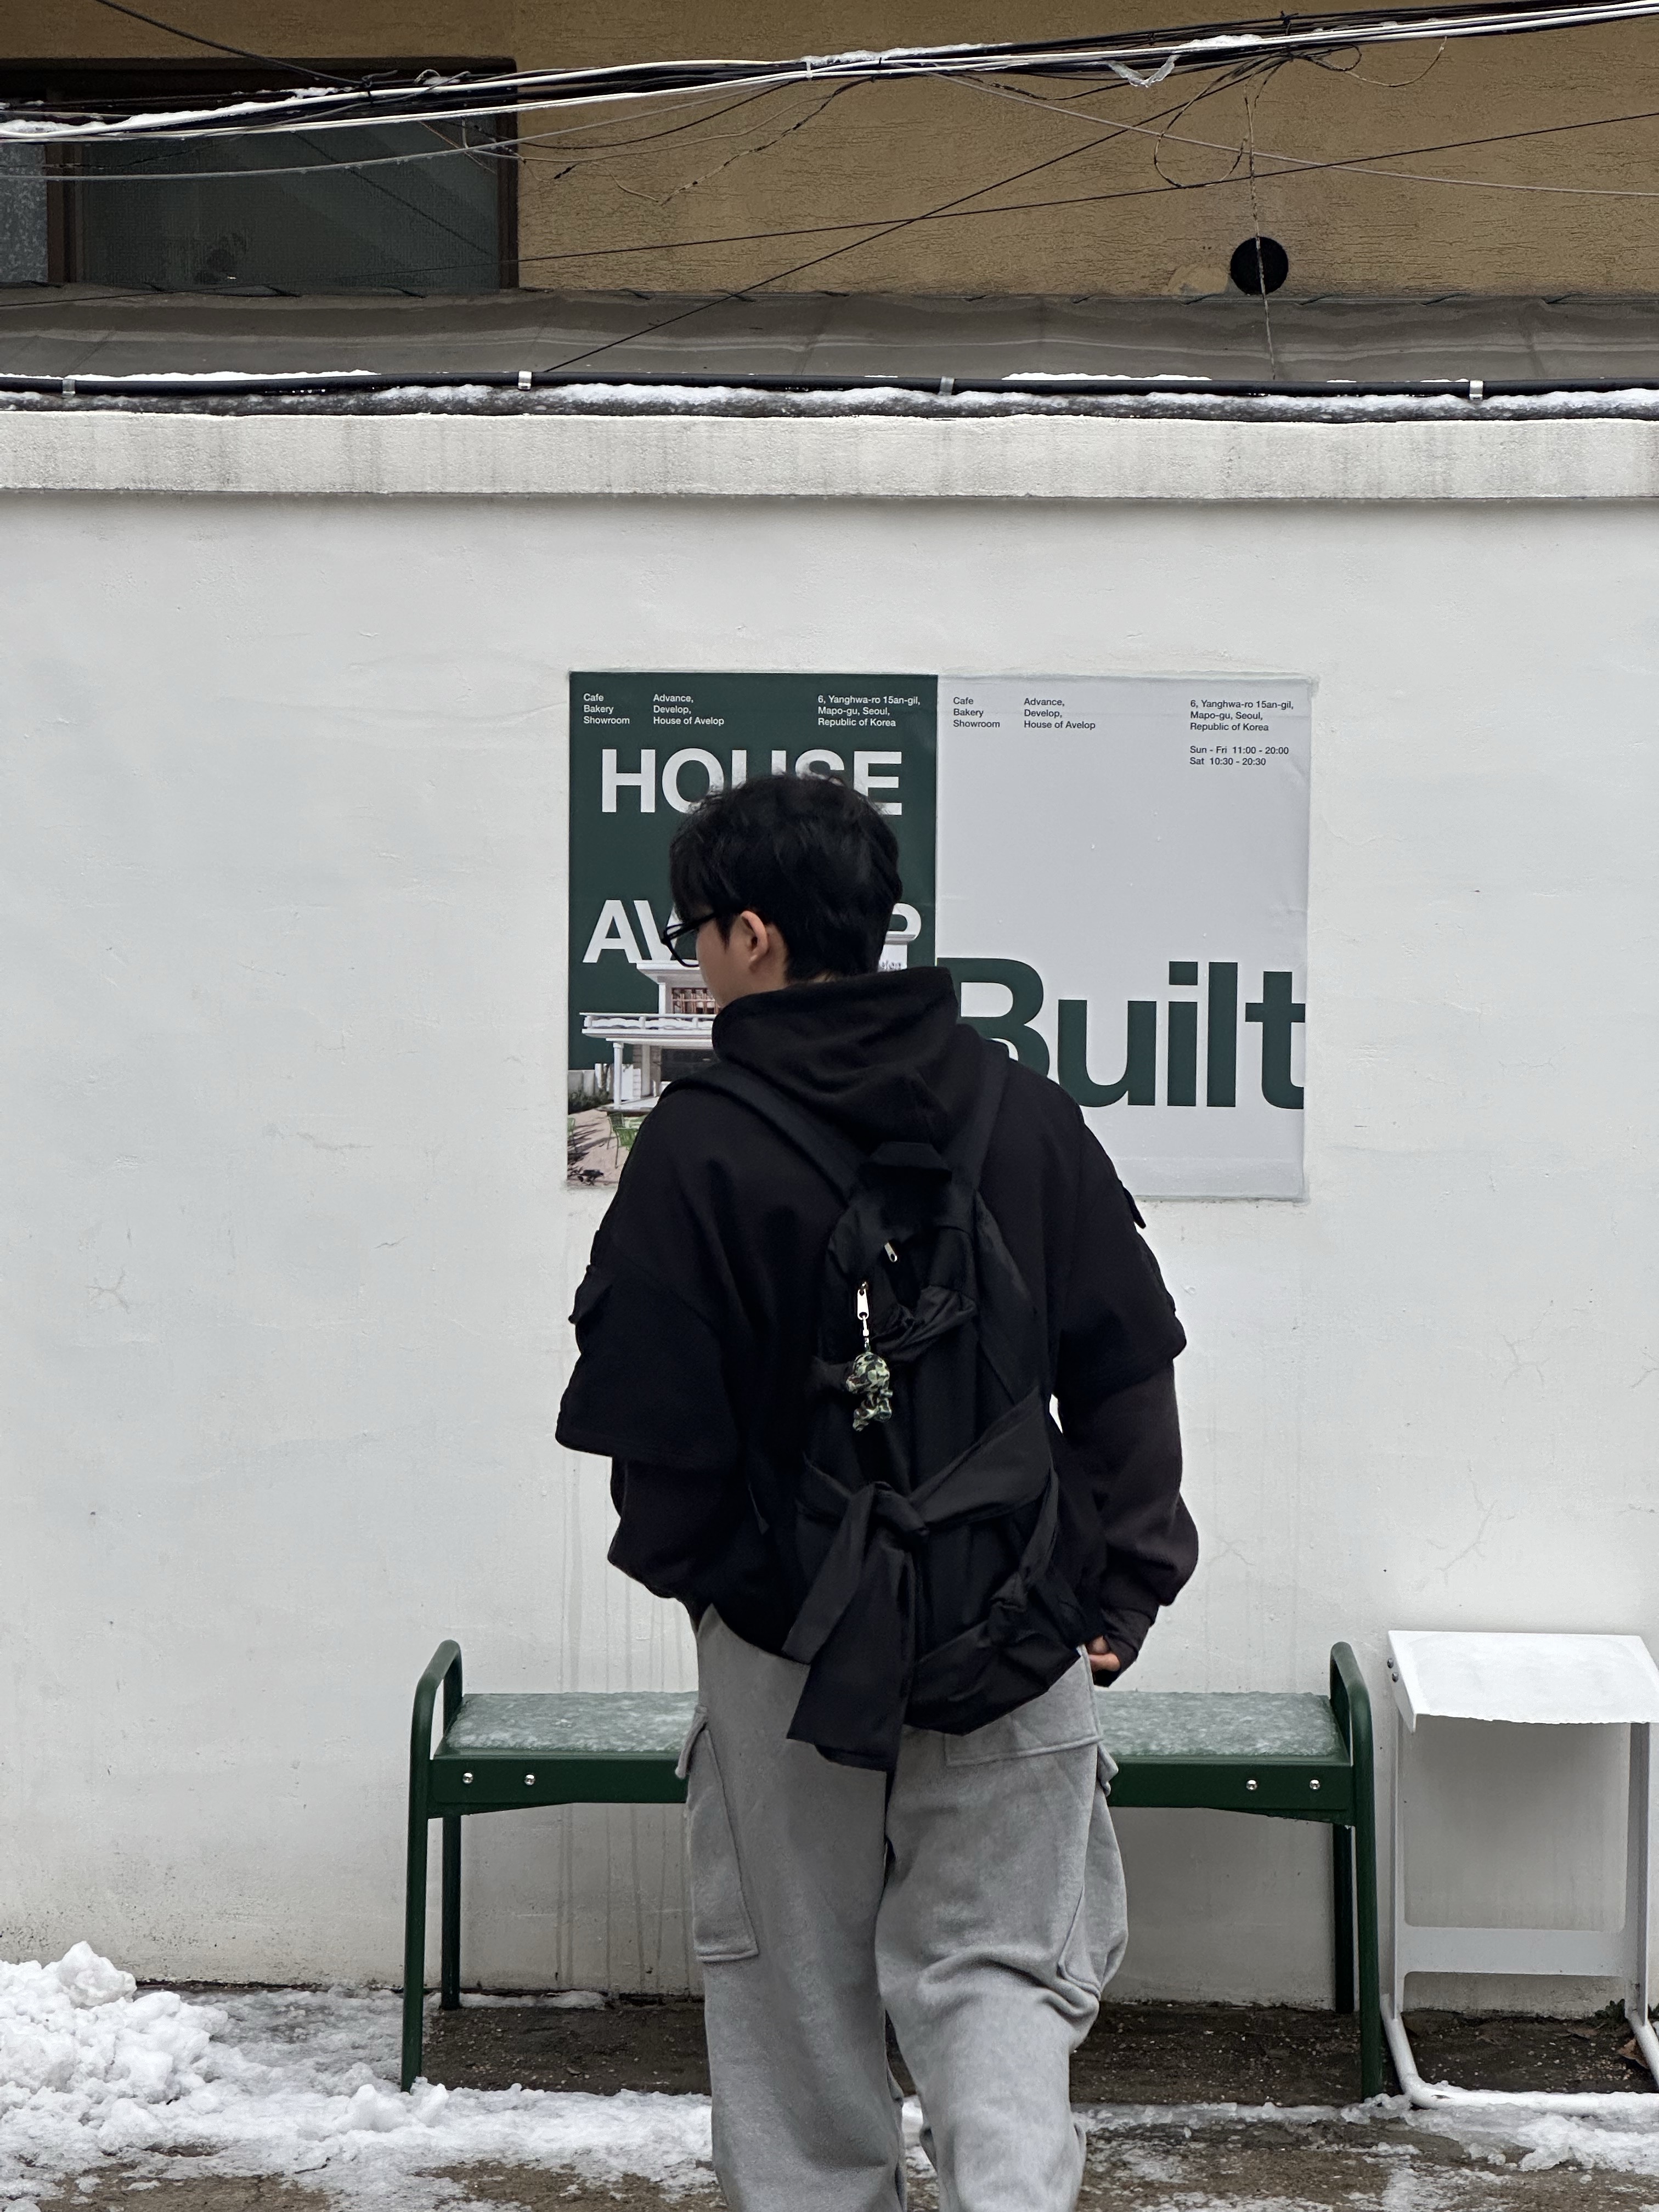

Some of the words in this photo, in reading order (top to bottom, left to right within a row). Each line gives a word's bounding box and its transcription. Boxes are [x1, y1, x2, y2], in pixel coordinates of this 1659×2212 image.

[583, 693, 604, 702] Cafe
[653, 693, 694, 703] Advance,
[817, 695, 826, 704] 6,
[828, 695, 881, 706] Yanghwa-ro
[883, 696, 921, 706] 15an-gil,
[953, 696, 974, 705] Cafe
[1024, 697, 1065, 707] Advance,
[583, 704, 614, 715] Bakery
[1190, 699, 1199, 709] 6,
[1200, 699, 1254, 709] Yanghwa-ro
[1256, 700, 1294, 710] 15an-gil,
[653, 705, 692, 715] Develop,
[817, 706, 860, 716] Mapo-gu,
[862, 707, 890, 716] Seoul,
[953, 708, 984, 718] Bakery
[1024, 709, 1063, 719] Develop,
[583, 715, 630, 725] Showroom
[1190, 710, 1233, 721] Mapo-gu,
[1235, 712, 1263, 721] Seoul,
[653, 716, 681, 725] House
[682, 716, 693, 725] of
[693, 716, 725, 726] Avelop
[817, 717, 857, 727] Republic
[858, 718, 868, 726] of
[870, 718, 896, 727] Korea
[953, 719, 1001, 728] Showroom
[1024, 720, 1053, 729] House
[1054, 720, 1064, 729] of
[1065, 720, 1096, 731] Avelop
[1190, 722, 1229, 732] Republic
[1231, 723, 1241, 731] of
[1243, 723, 1269, 731] Korea
[1189, 745, 1207, 754] Sun
[1216, 746, 1228, 754] Fri
[1232, 746, 1257, 754] 11:00
[1265, 746, 1289, 755] 20:00
[1189, 757, 1205, 765] Sat
[1210, 757, 1234, 765] 10:30
[1242, 758, 1267, 766] 20:30
[936, 957, 1306, 1110] Built
